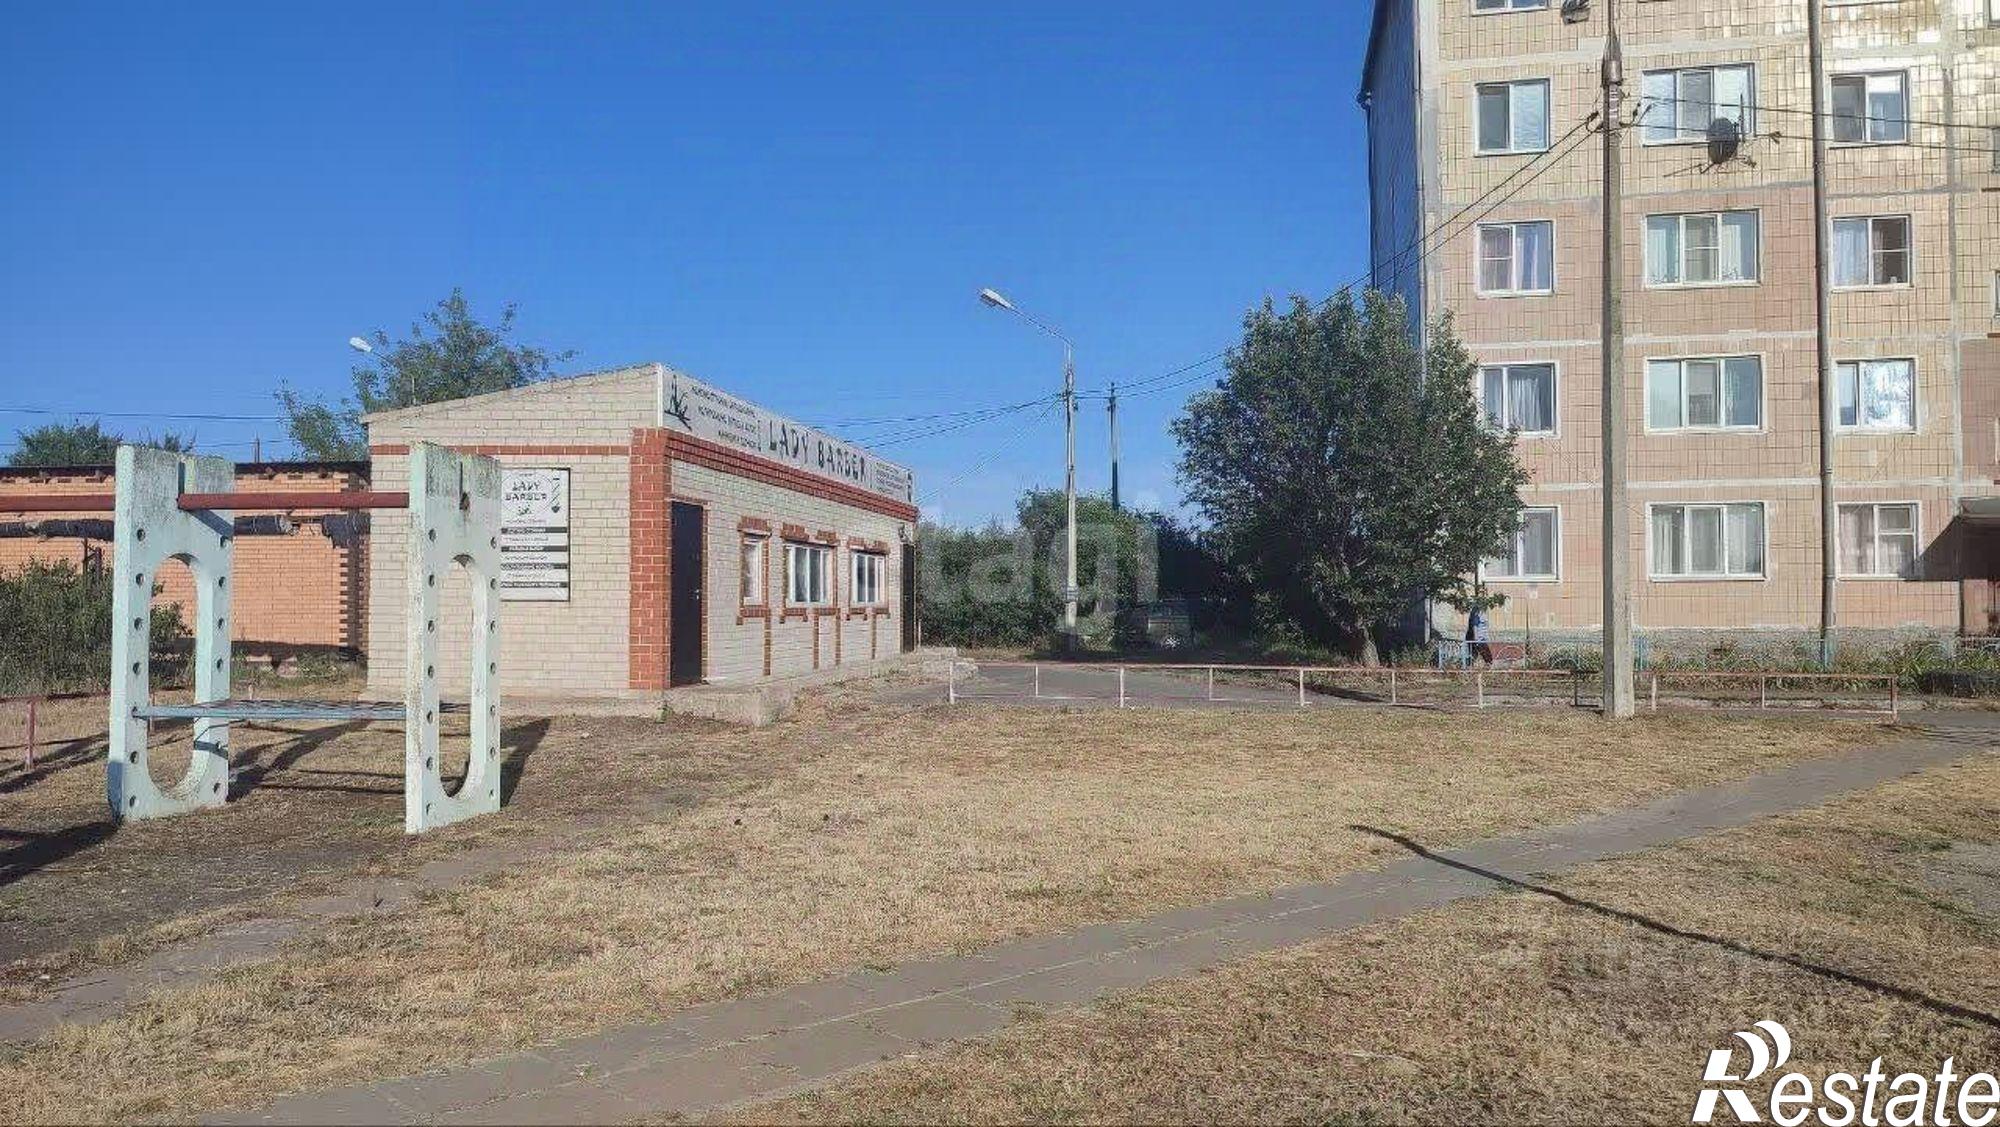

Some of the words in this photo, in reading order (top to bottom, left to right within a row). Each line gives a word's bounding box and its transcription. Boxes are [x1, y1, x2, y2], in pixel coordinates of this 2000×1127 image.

[769, 419, 808, 465] LADY
[817, 439, 867, 484] BARBER
[511, 480, 541, 491] LADY
[504, 492, 548, 501] BARBER
